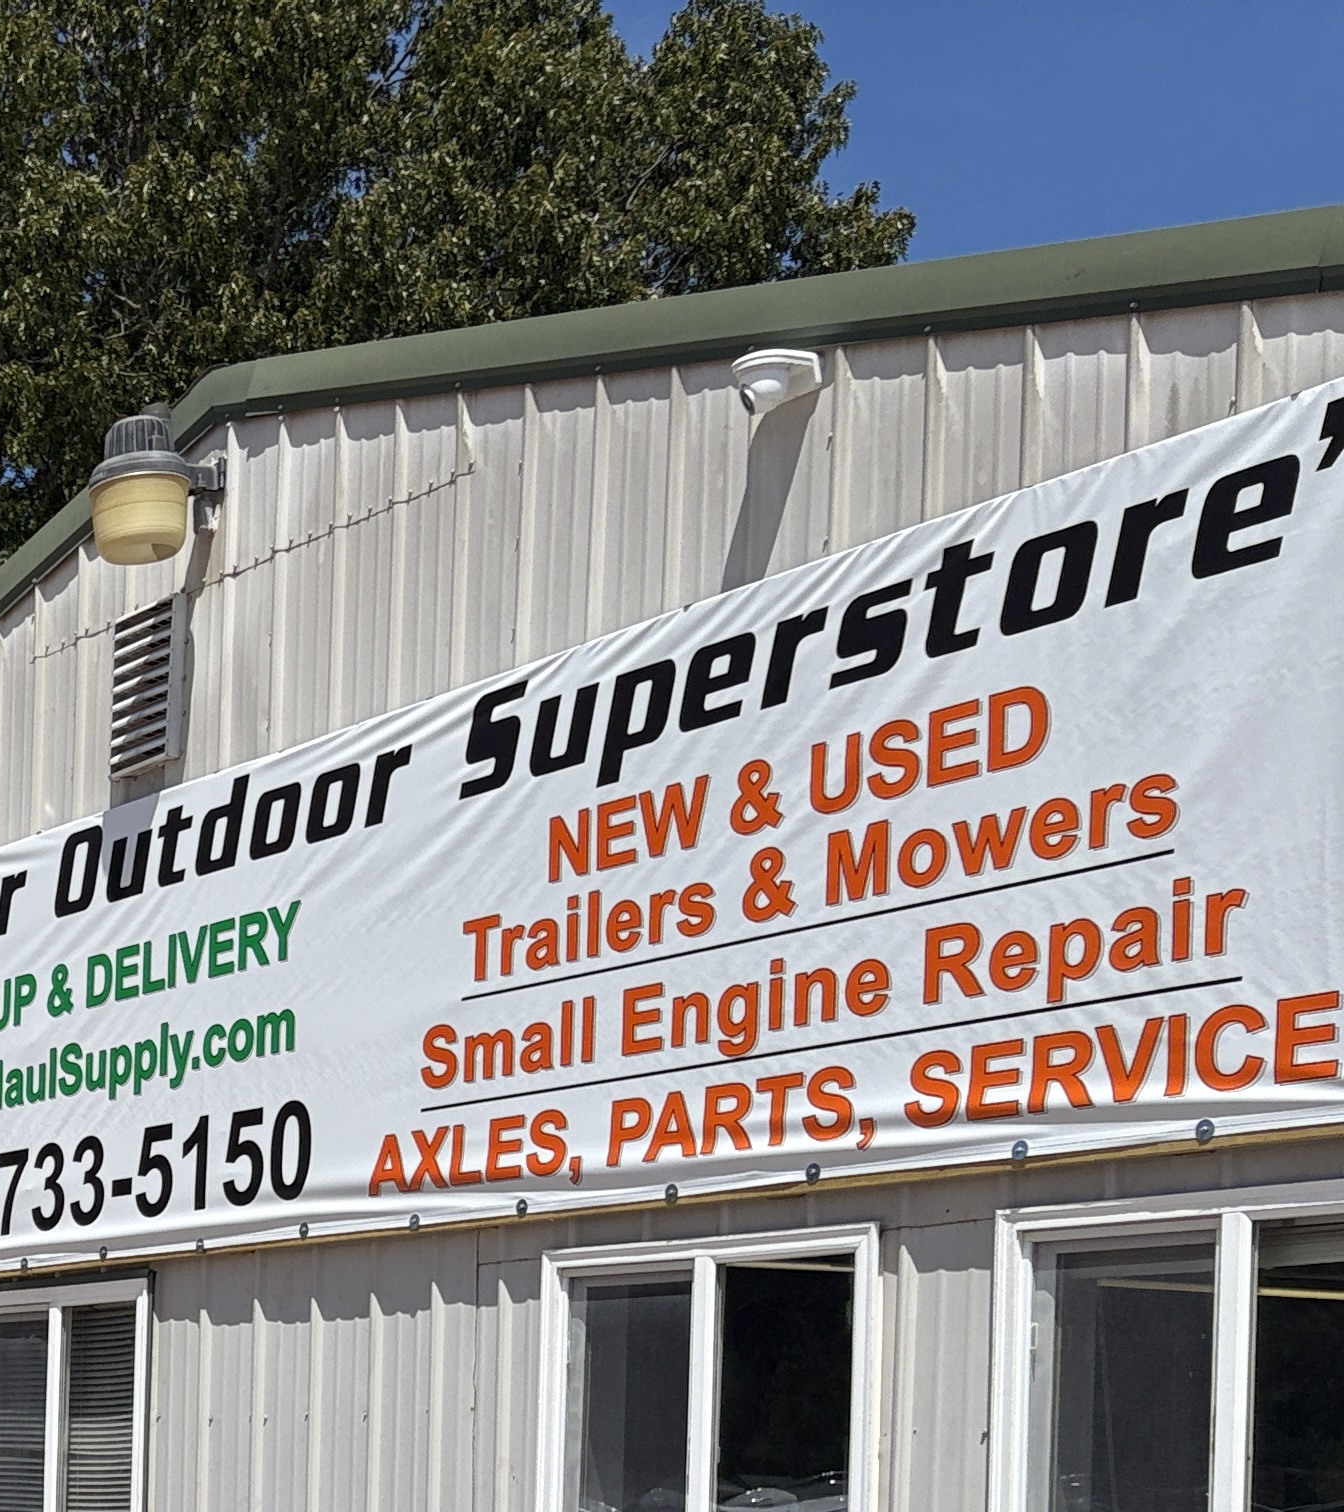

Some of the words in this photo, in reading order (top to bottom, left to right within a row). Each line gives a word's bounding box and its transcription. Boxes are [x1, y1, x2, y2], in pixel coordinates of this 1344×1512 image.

[55, 745, 412, 917] Outdoor
[464, 883, 714, 980] Trailers
[743, 847, 795, 922] &
[827, 774, 1176, 904] Mowers
[550, 775, 708, 881] NEW
[731, 760, 782, 834] &
[811, 687, 1048, 814] USED
[48, 964, 73, 1016] &
[87, 901, 299, 1007] DELIVERY
[422, 997, 594, 1088] Small
[622, 959, 889, 1056] Engine
[924, 878, 1245, 1003] Repair
[370, 1110, 580, 1195] AXLES,
[608, 1066, 874, 1166] PARTS,
[905, 991, 1339, 1127] SERVICE
